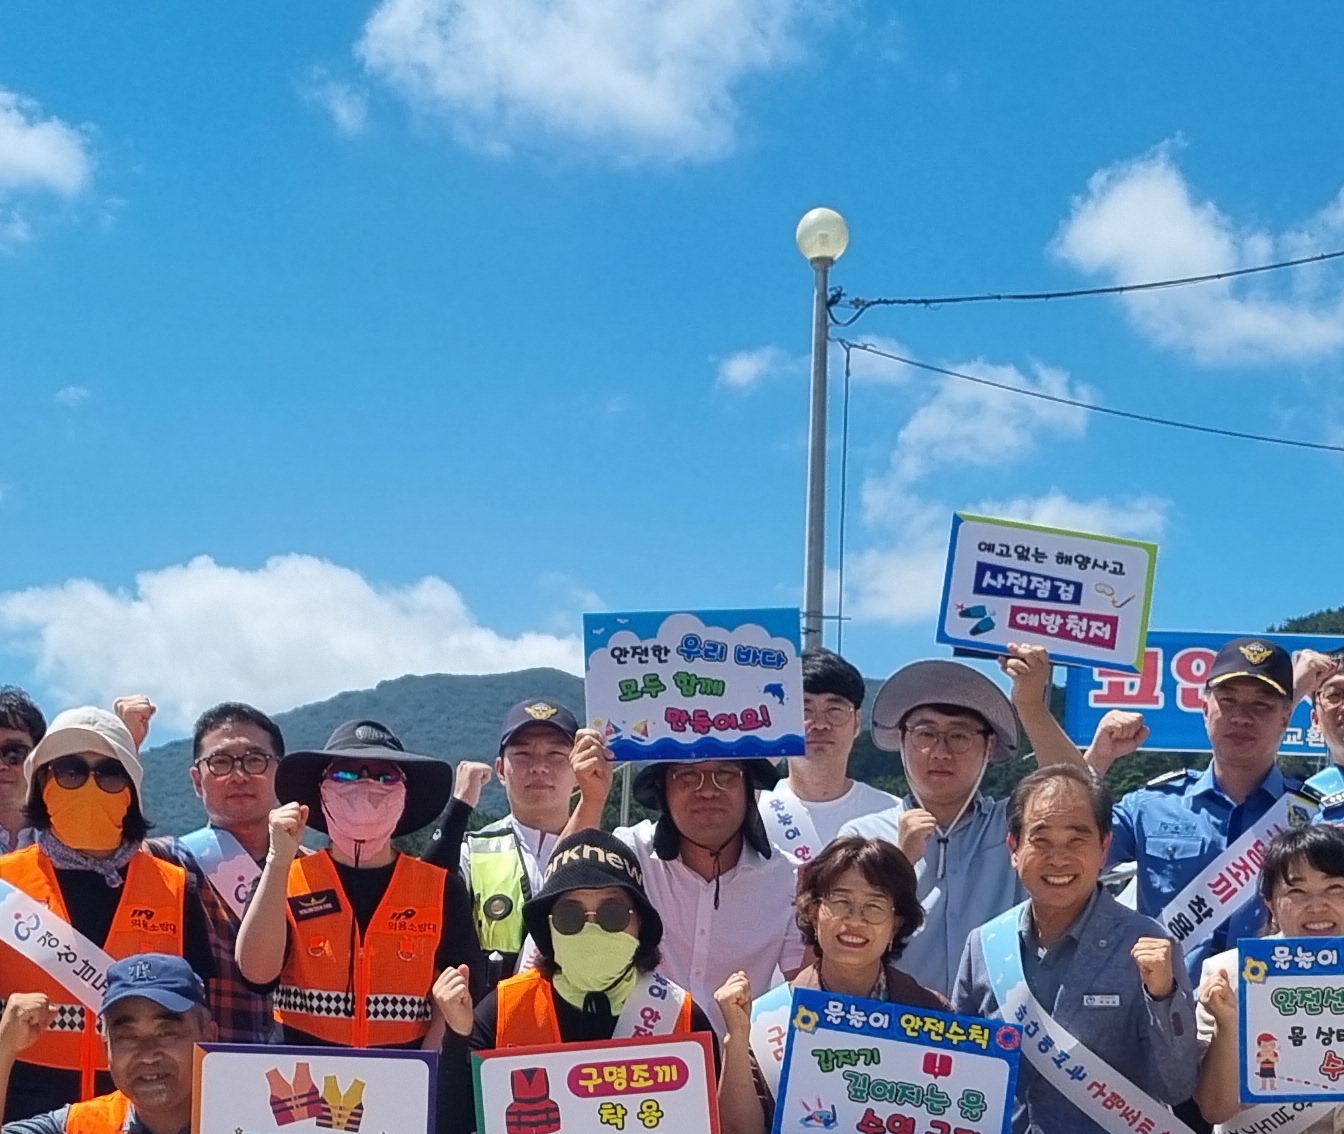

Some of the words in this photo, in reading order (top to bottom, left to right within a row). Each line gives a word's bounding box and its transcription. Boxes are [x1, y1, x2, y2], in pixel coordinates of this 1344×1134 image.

[977, 541, 1048, 564] 예고없는
[1055, 552, 1125, 576] 해양사고
[981, 570, 1075, 601] 사전점검
[1015, 611, 1112, 640] 예방철저
[610, 644, 671, 664] 안전한
[677, 633, 727, 662] 우리
[734, 645, 788, 670] 바다
[618, 673, 667, 702] 모두
[672, 671, 726, 697] 함께
[665, 705, 772, 734] 만들어요!
[769, 799, 801, 840] 물놀이
[388, 920, 437, 933] 의용소방대
[1167, 894, 1215, 942] 착용
[1270, 946, 1338, 969] 물놀이
[824, 1000, 889, 1029] 물놀이
[900, 1013, 990, 1050] 안전수칙
[1288, 1026, 1307, 1047] 몸
[1013, 1003, 1087, 1083] 바다에서는
[811, 1048, 881, 1073] 갑자기
[578, 1064, 678, 1093] 구명조끼
[843, 1070, 952, 1115] 깊어지는
[958, 1089, 987, 1121] 물
